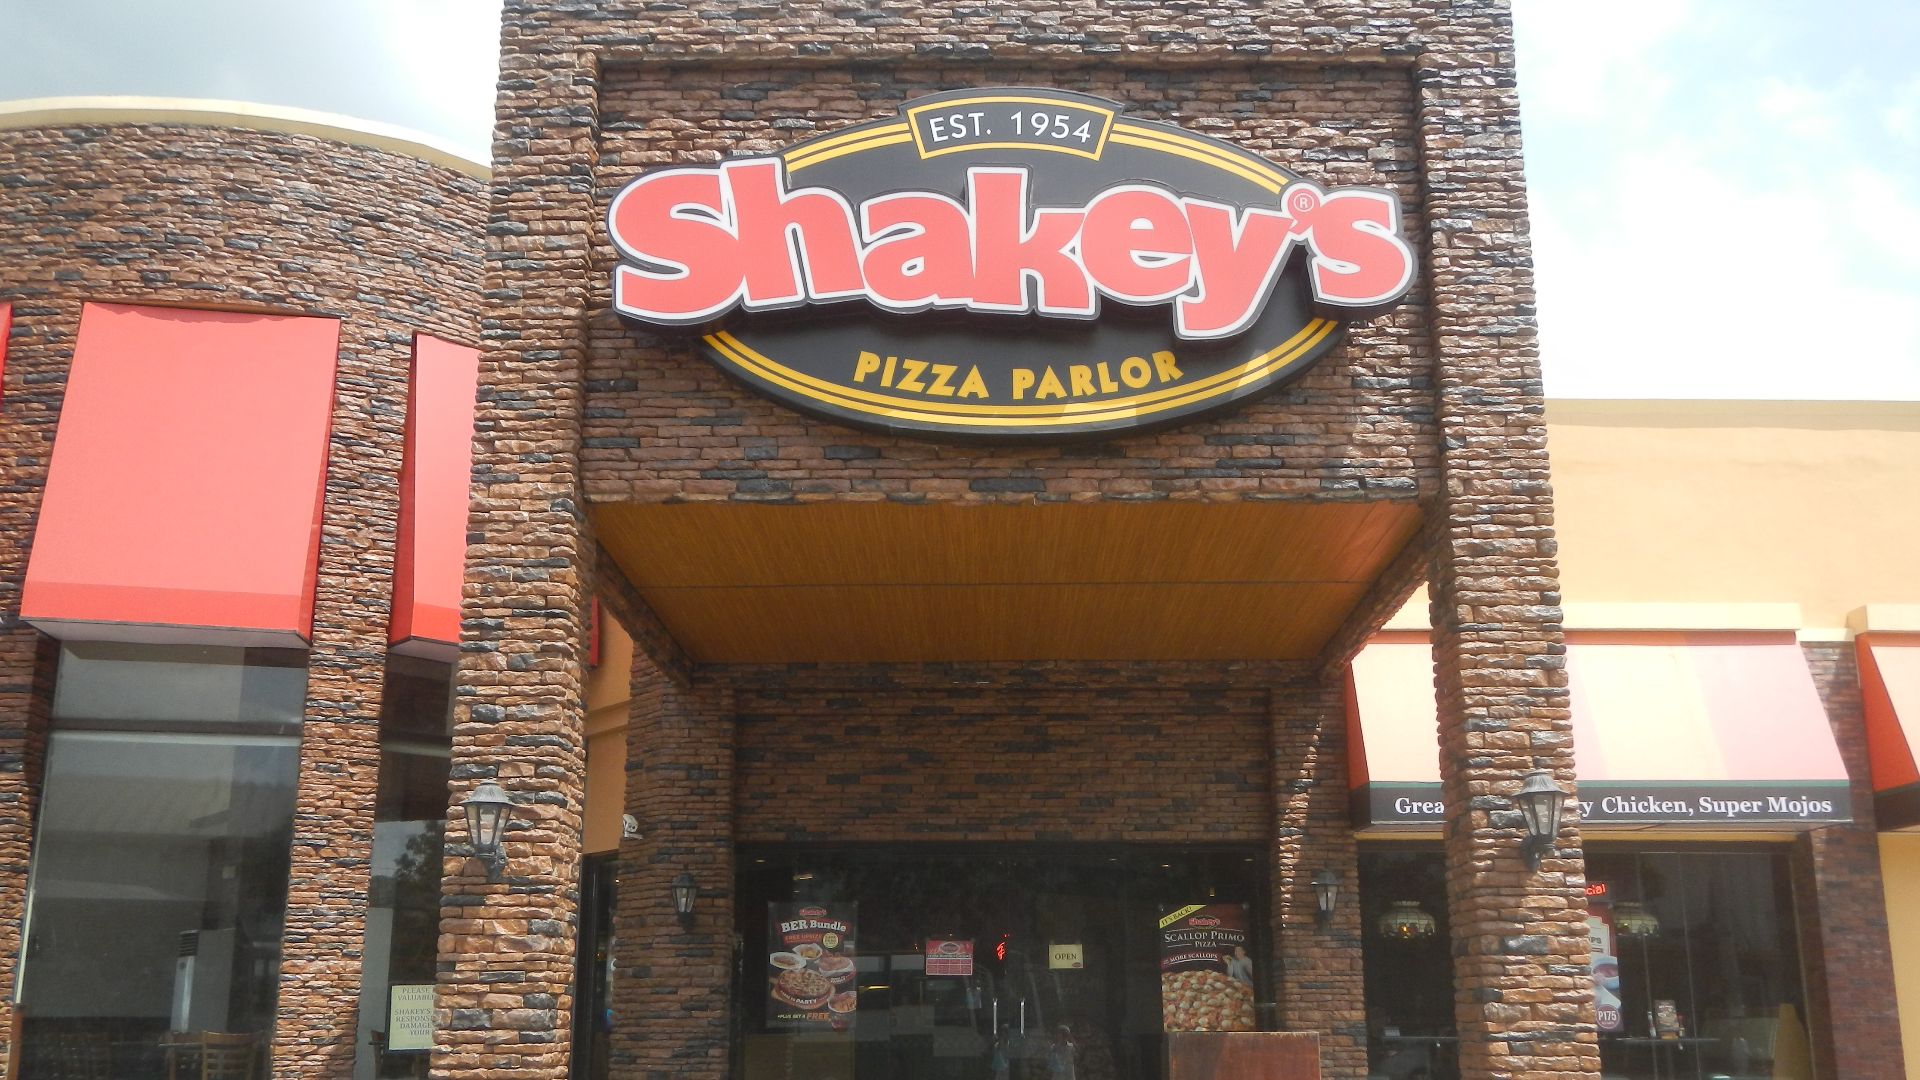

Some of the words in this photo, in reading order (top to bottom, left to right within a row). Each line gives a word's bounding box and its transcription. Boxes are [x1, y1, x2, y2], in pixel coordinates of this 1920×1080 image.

[929, 112, 991, 142] EST.
[1010, 111, 1091, 143] 1954
[608, 157, 1413, 338] Shakey's
[853, 350, 989, 399] PIZZA
[1012, 350, 1184, 399] PARLOR
[1395, 797, 1444, 814] Grea
[1602, 795, 1694, 816] Chicken,
[1699, 796, 1762, 817] Super
[1766, 796, 1832, 817] Mojos
[1585, 883, 1606, 895] cial
[781, 920, 808, 932] BER
[810, 920, 847, 932] Bundle
[1164, 931, 1208, 943] SCALLOP
[1211, 931, 1245, 942] PRIMO
[1054, 953, 1077, 961] OPEN
[1170, 954, 1187, 962] MORE
[807, 1012, 830, 1020] FREE
[1598, 1010, 1617, 1021] P175
